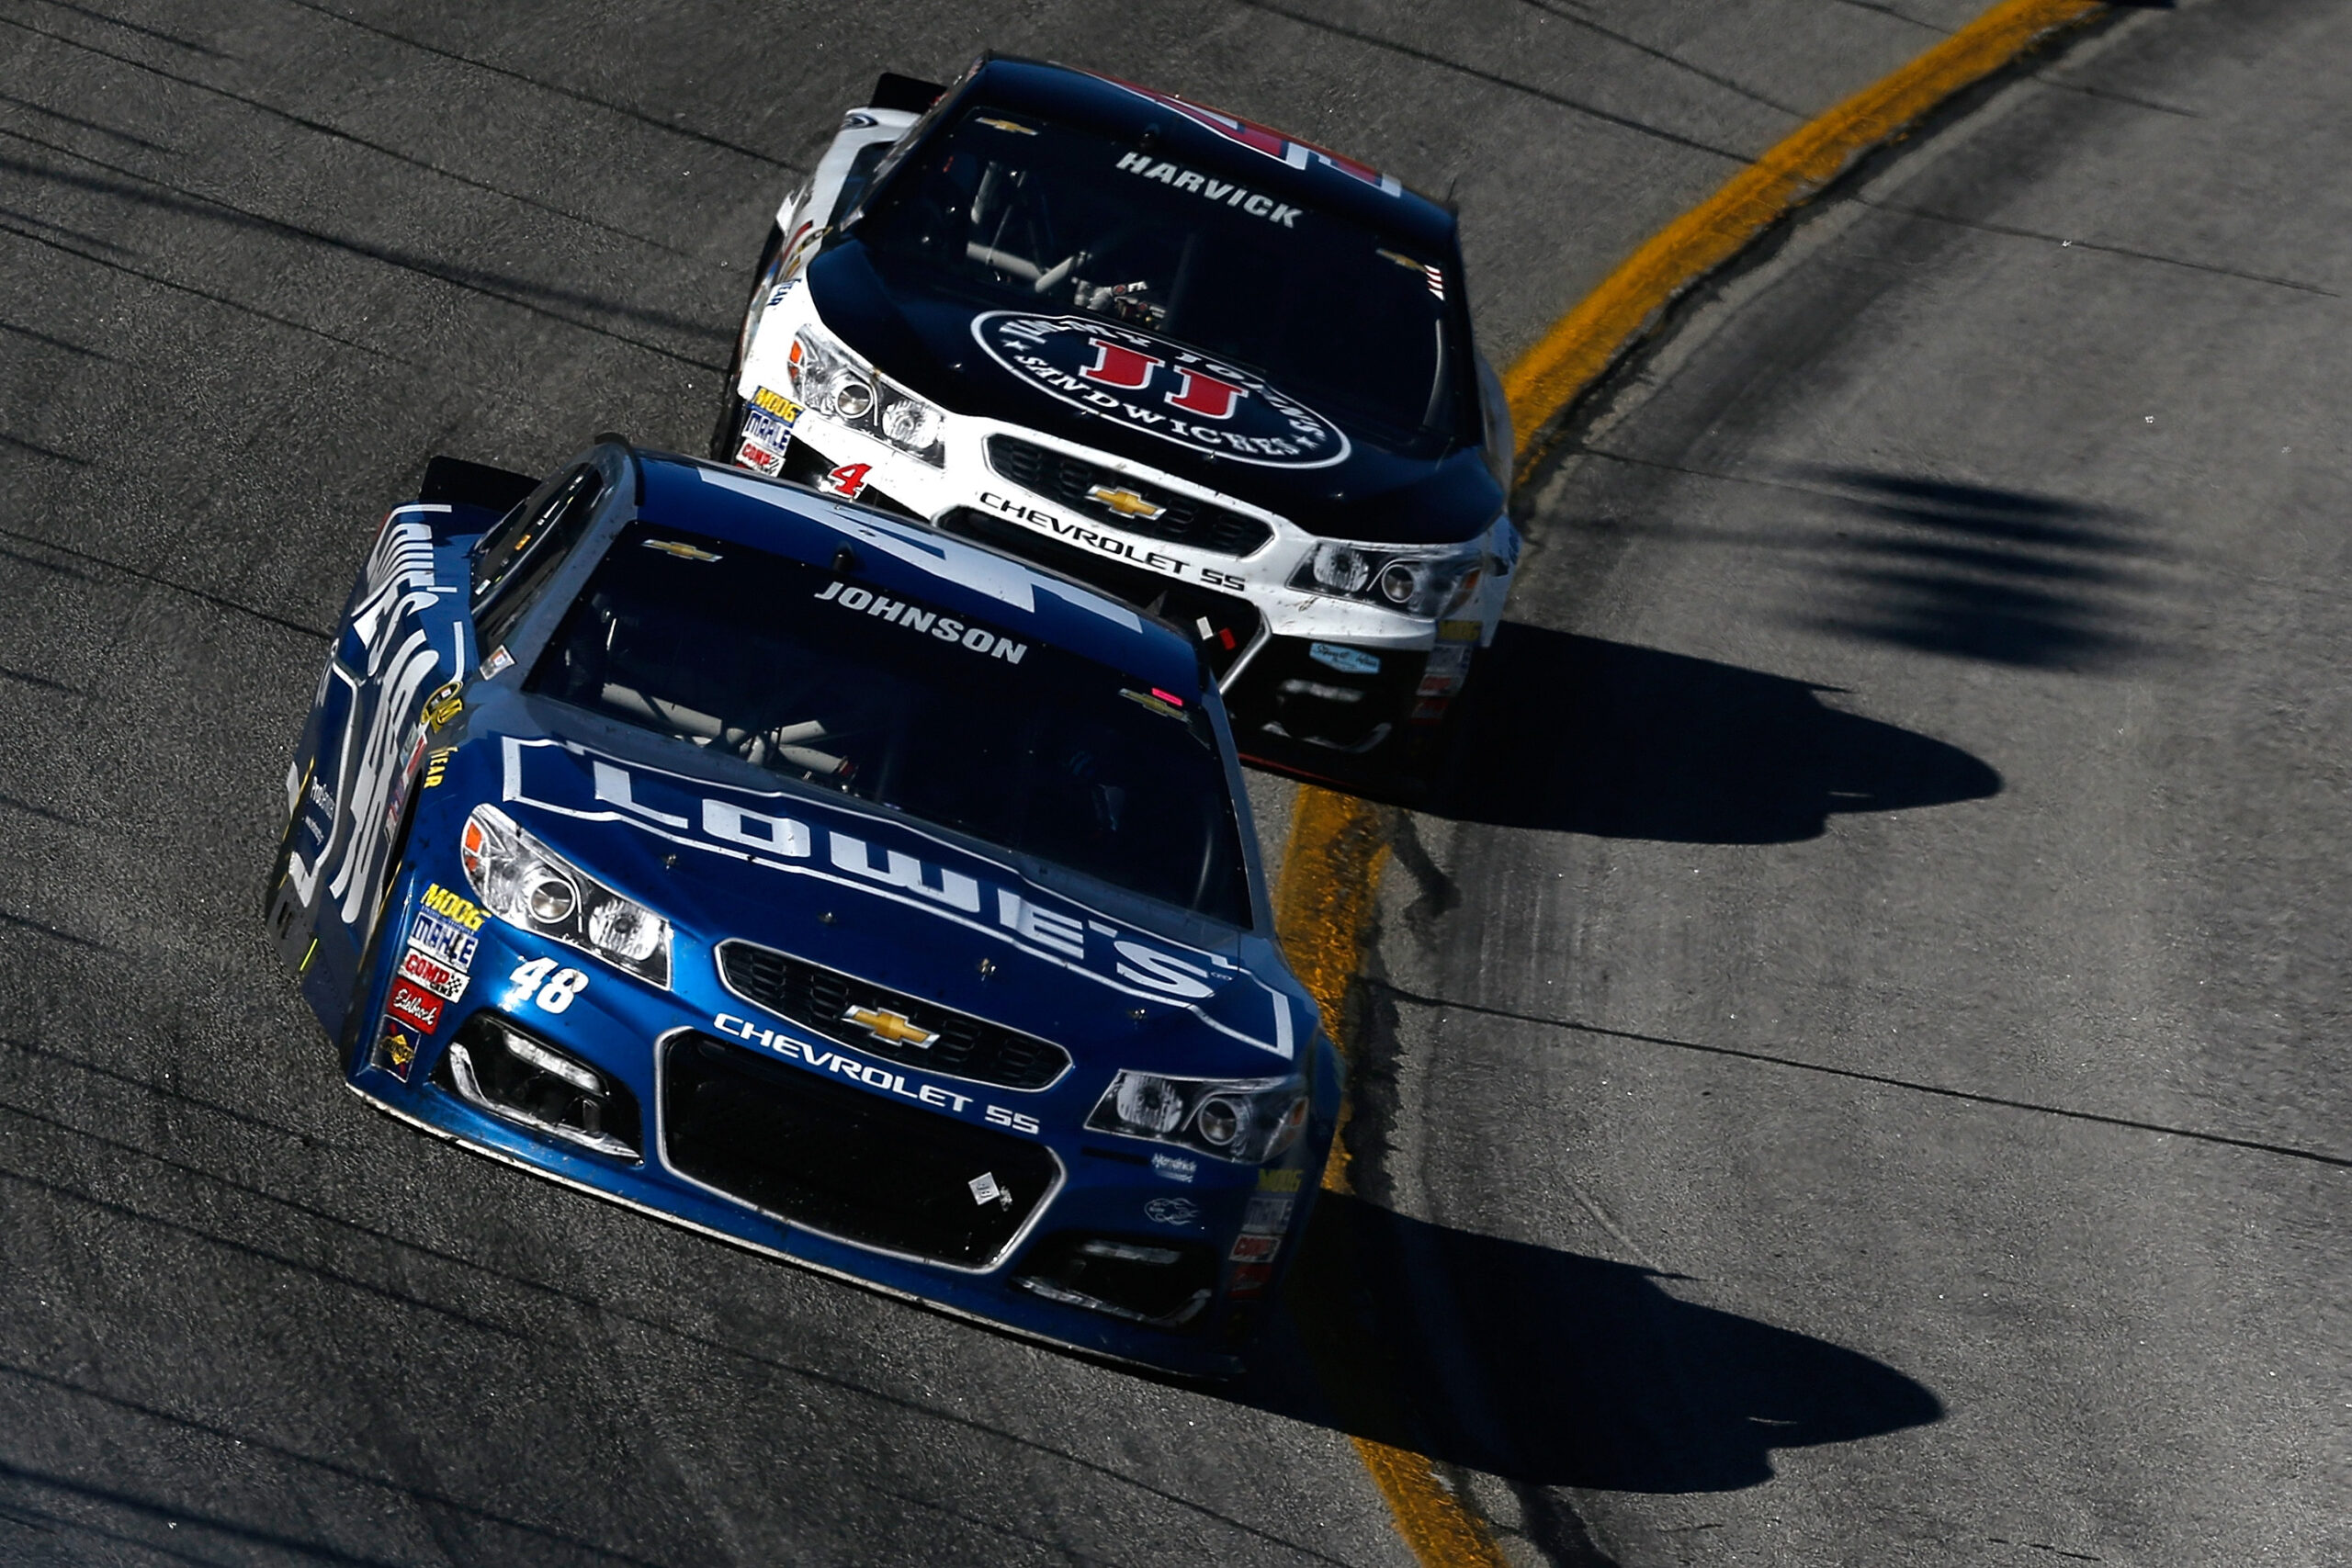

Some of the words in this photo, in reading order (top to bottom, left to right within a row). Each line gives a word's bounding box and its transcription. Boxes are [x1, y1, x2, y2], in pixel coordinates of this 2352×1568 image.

[1115, 152, 1303, 228] HARVICK
[752, 386, 804, 424] MOOG
[1014, 355, 1303, 457] SANDWICHES
[1079, 337, 1250, 420] JJ
[831, 463, 873, 500] 4
[979, 492, 1191, 575] CHEVROLET
[1200, 568, 1247, 592] SS
[814, 581, 1028, 664] JOHNSON
[420, 882, 492, 934] MOOG
[593, 761, 1214, 998] LOWE'S
[393, 988, 438, 1026] Edelbrock
[404, 953, 450, 986] COMP
[508, 956, 589, 1014] 48
[713, 1012, 973, 1112] CHEVROLET
[985, 1104, 1040, 1135] SS
